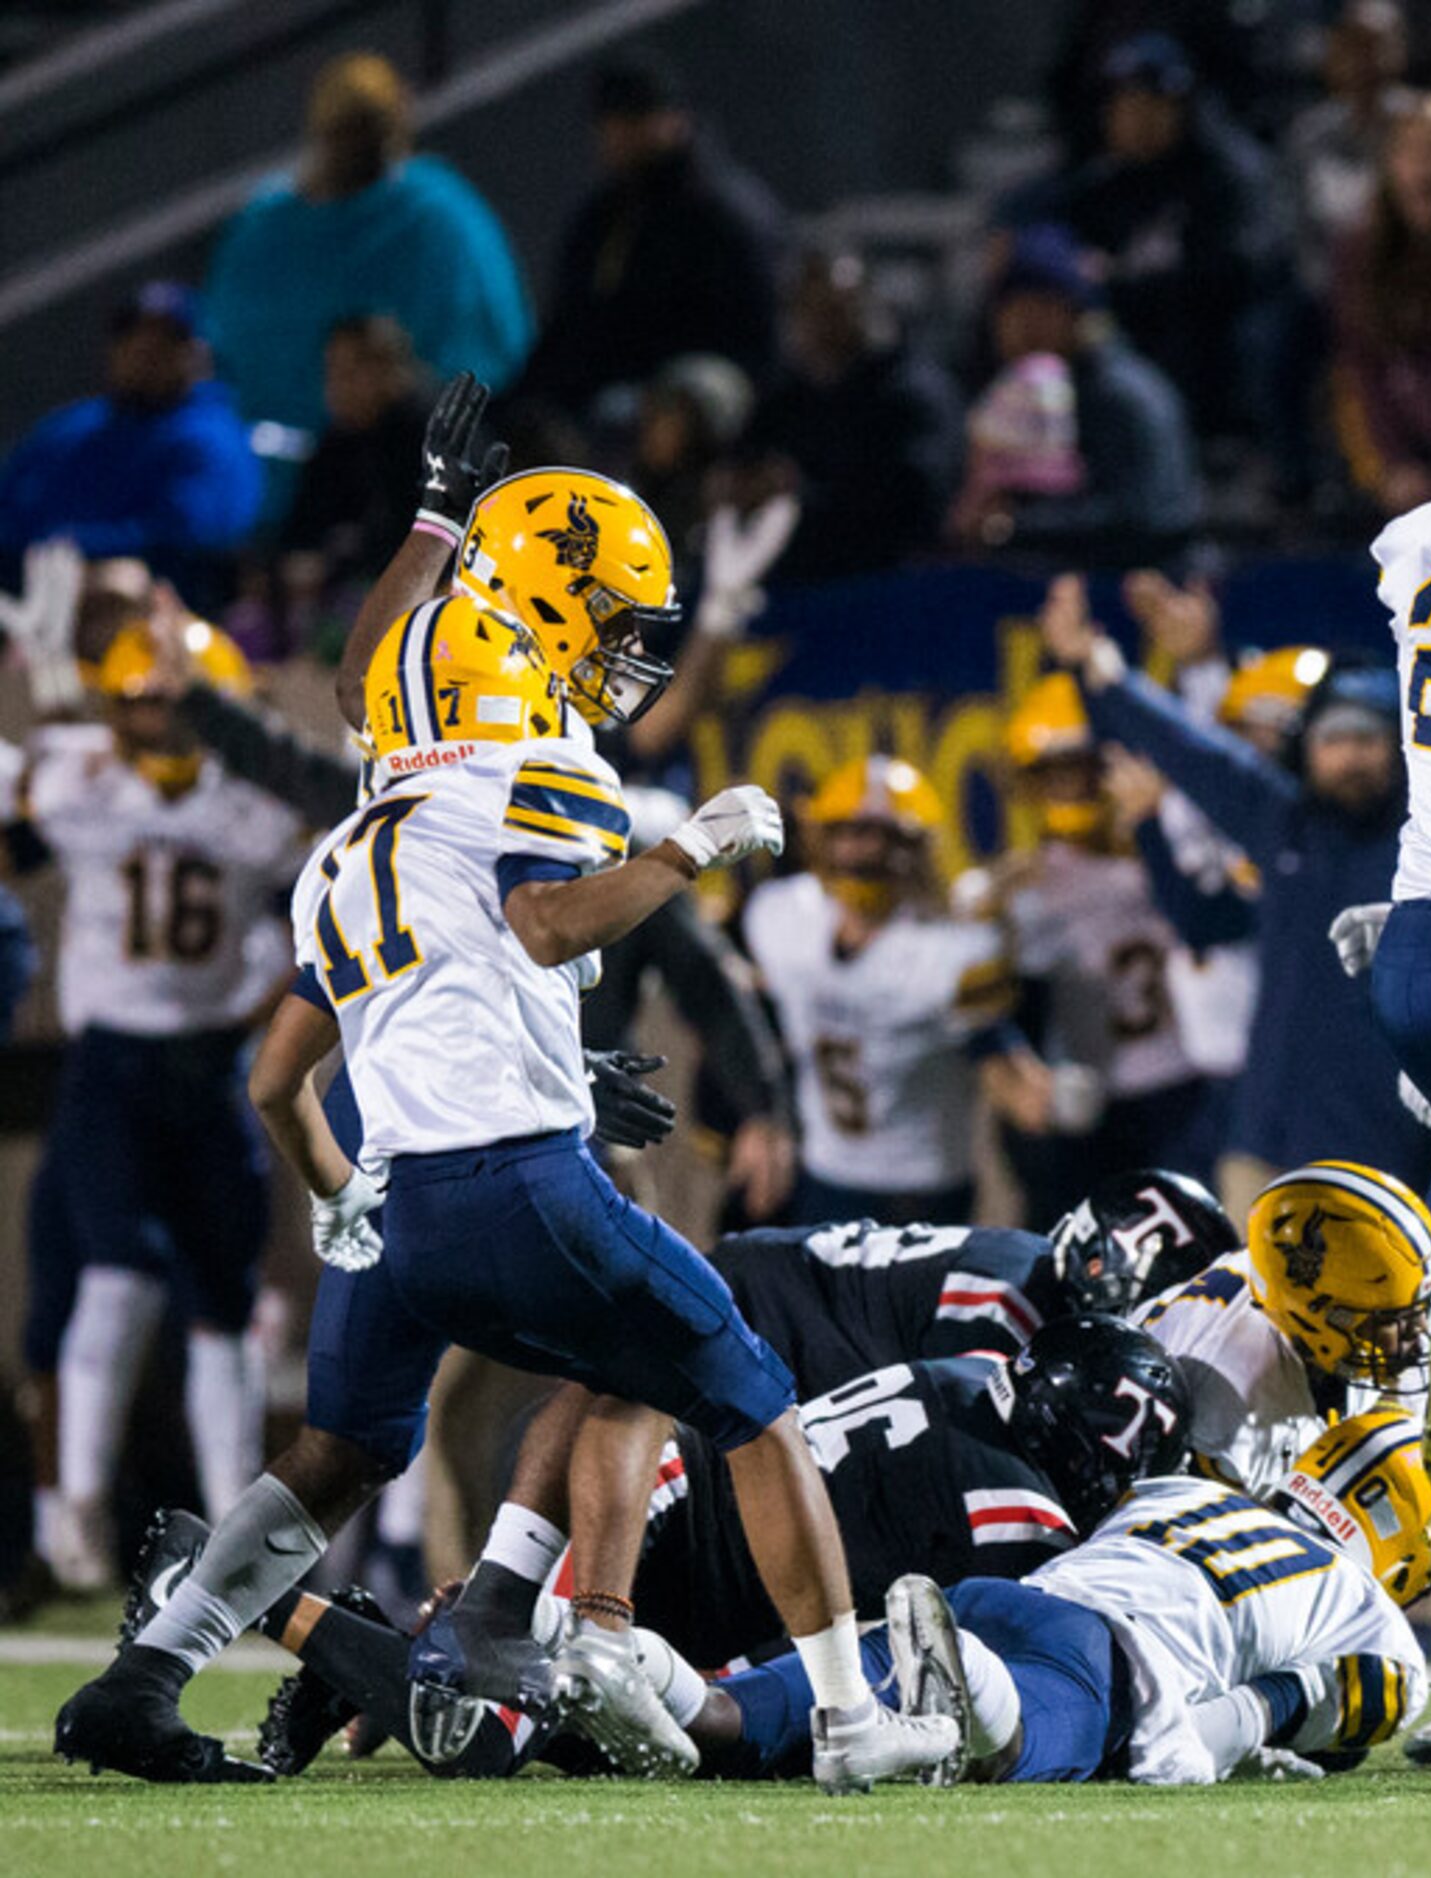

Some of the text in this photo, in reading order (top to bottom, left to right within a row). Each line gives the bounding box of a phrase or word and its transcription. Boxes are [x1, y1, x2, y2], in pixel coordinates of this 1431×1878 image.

[387, 695, 404, 733] 1
[437, 686, 461, 727] 7
[119, 844, 223, 966] 16
[315, 793, 433, 1007] 17
[1111, 1186, 1195, 1263] T
[1101, 1376, 1177, 1459] T
[1288, 1473, 1358, 1542] Riddell
[1316, 1439, 1388, 1509] 1 0
[1127, 1493, 1349, 1608] 10
